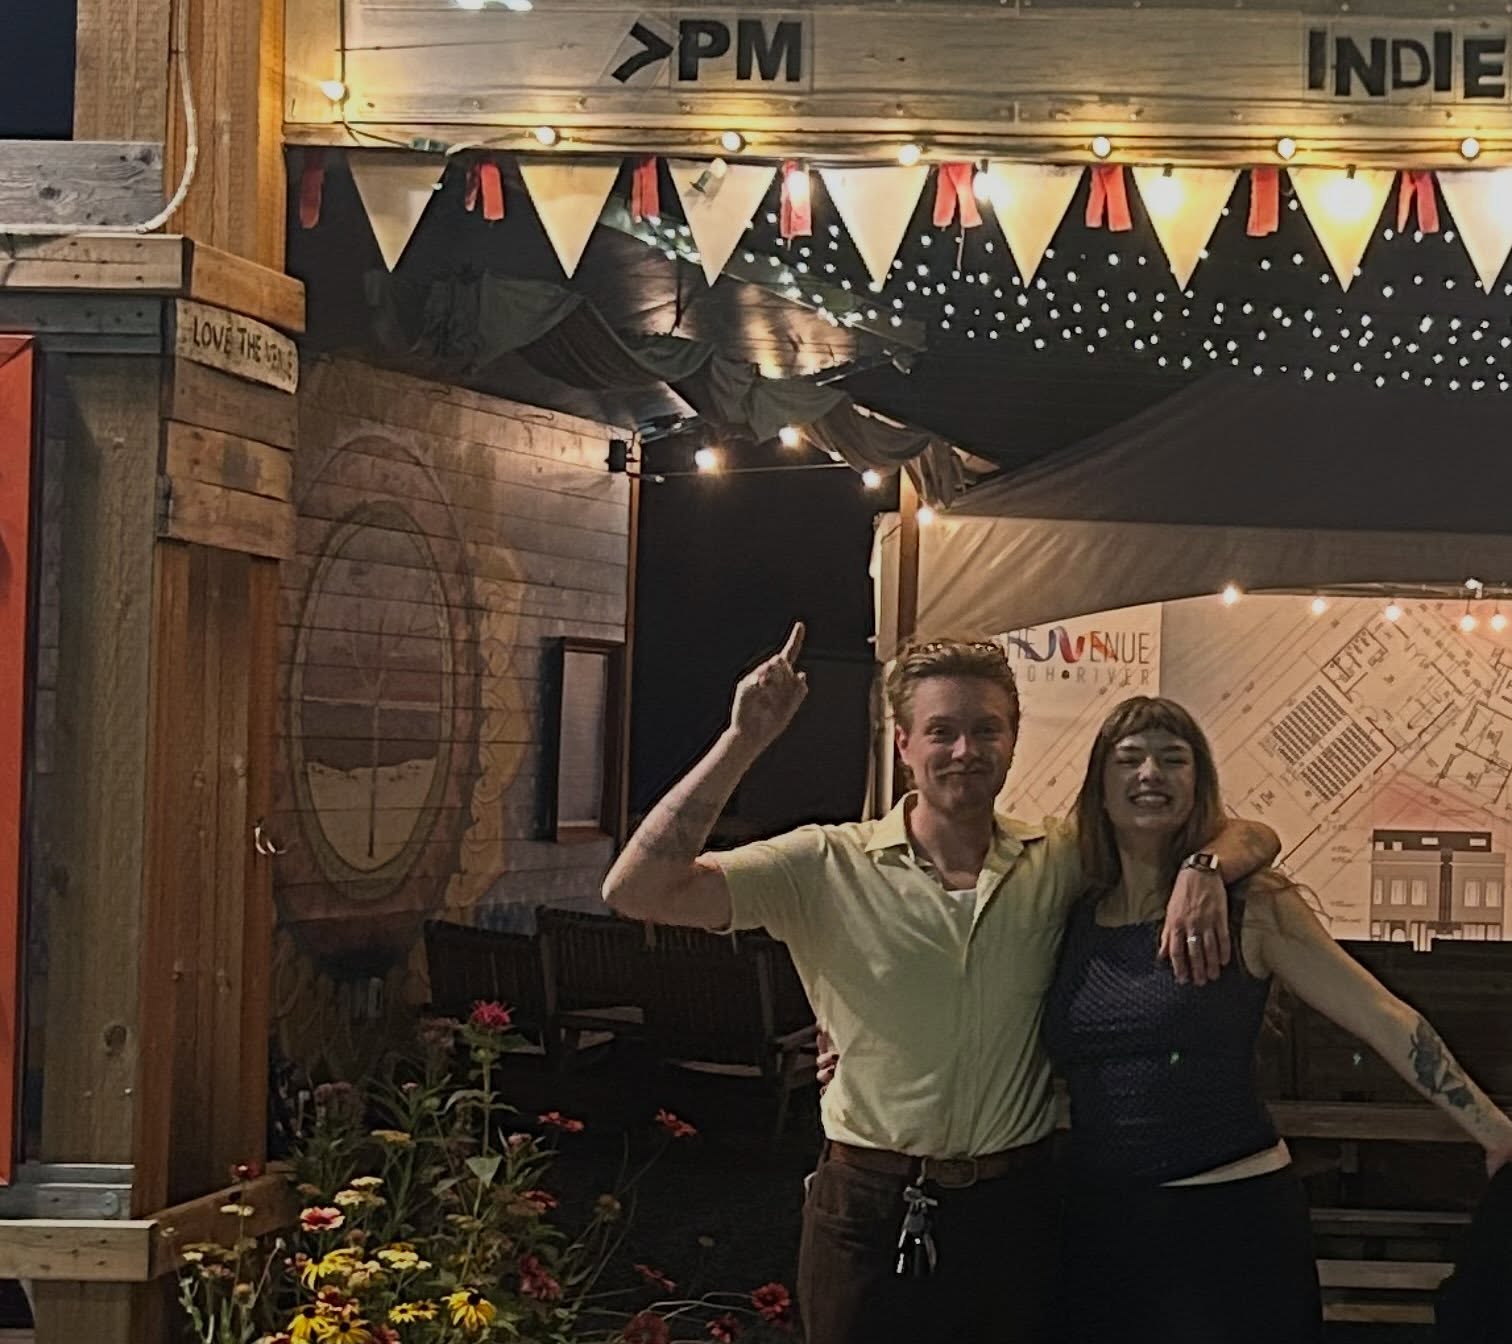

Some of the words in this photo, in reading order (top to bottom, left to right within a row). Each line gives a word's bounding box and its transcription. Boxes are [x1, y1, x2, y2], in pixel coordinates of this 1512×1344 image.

[1307, 28, 1507, 99] INDIE
[192, 316, 232, 355] LOVE
[237, 327, 262, 362] THE
[1007, 628, 1037, 660] HE
[1014, 665, 1054, 683] IGH
[1076, 666, 1150, 686] RIVER
